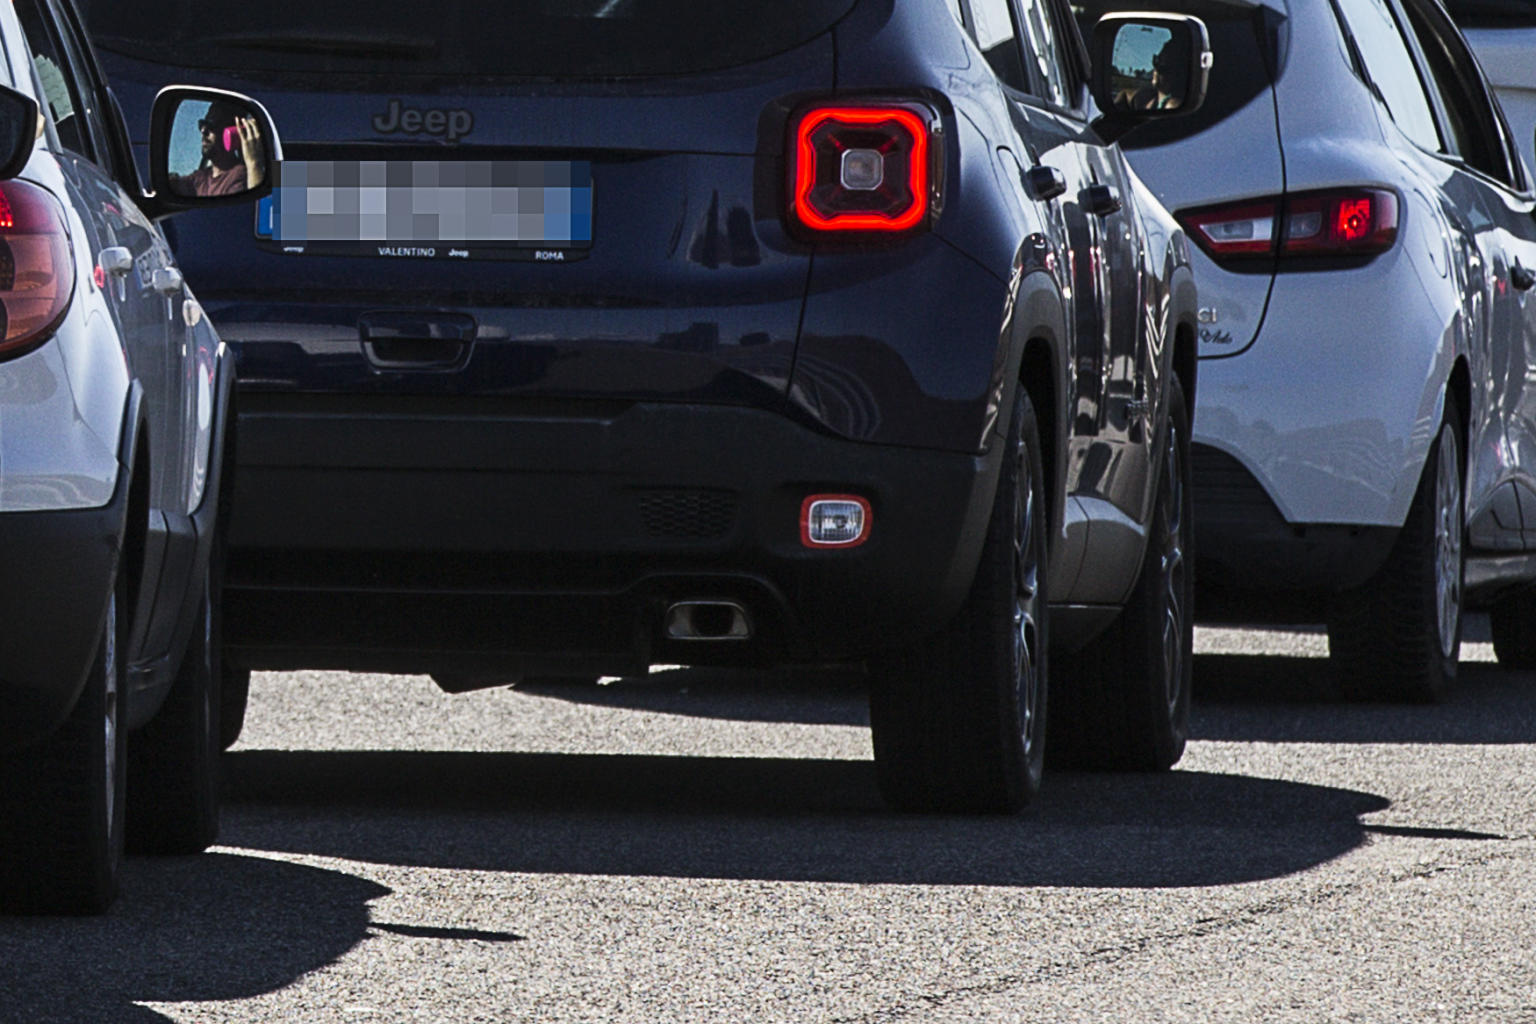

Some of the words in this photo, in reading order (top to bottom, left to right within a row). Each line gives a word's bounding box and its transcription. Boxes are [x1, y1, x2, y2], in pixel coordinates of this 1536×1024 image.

[372, 99, 474, 139] Jeep
[378, 247, 435, 257] VALENTINO
[535, 251, 564, 260] ROMA
